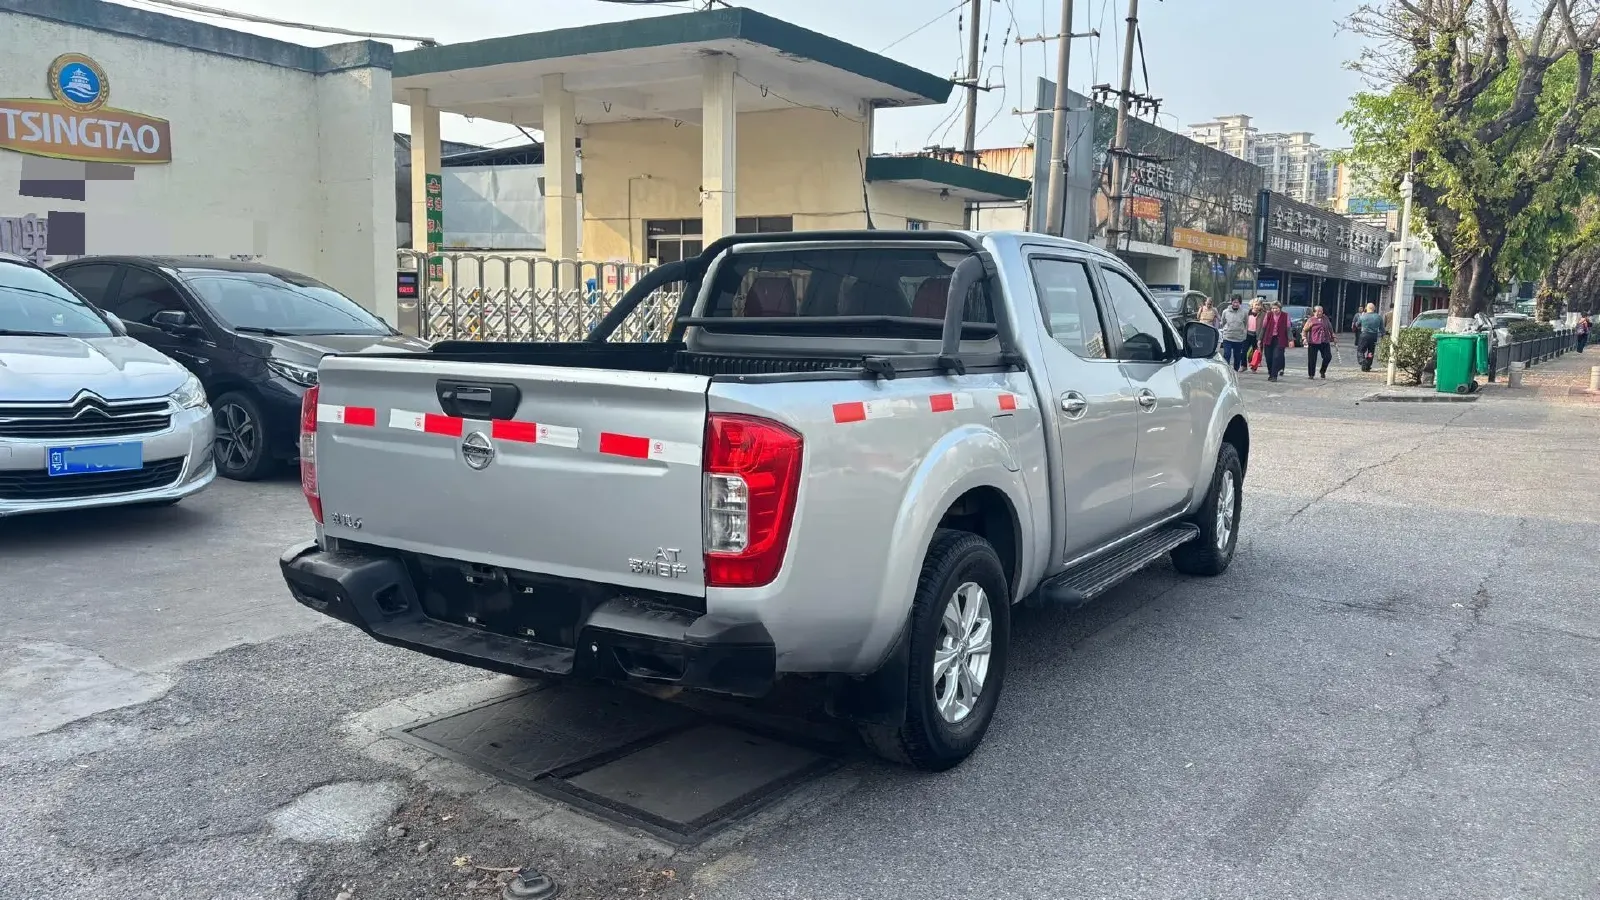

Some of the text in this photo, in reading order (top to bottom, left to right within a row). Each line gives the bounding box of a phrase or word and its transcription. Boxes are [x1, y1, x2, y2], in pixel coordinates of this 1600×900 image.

[0, 107, 160, 154] TSINGTAO
[655, 546, 682, 562] AT
[628, 557, 688, 579] 郑州日产
